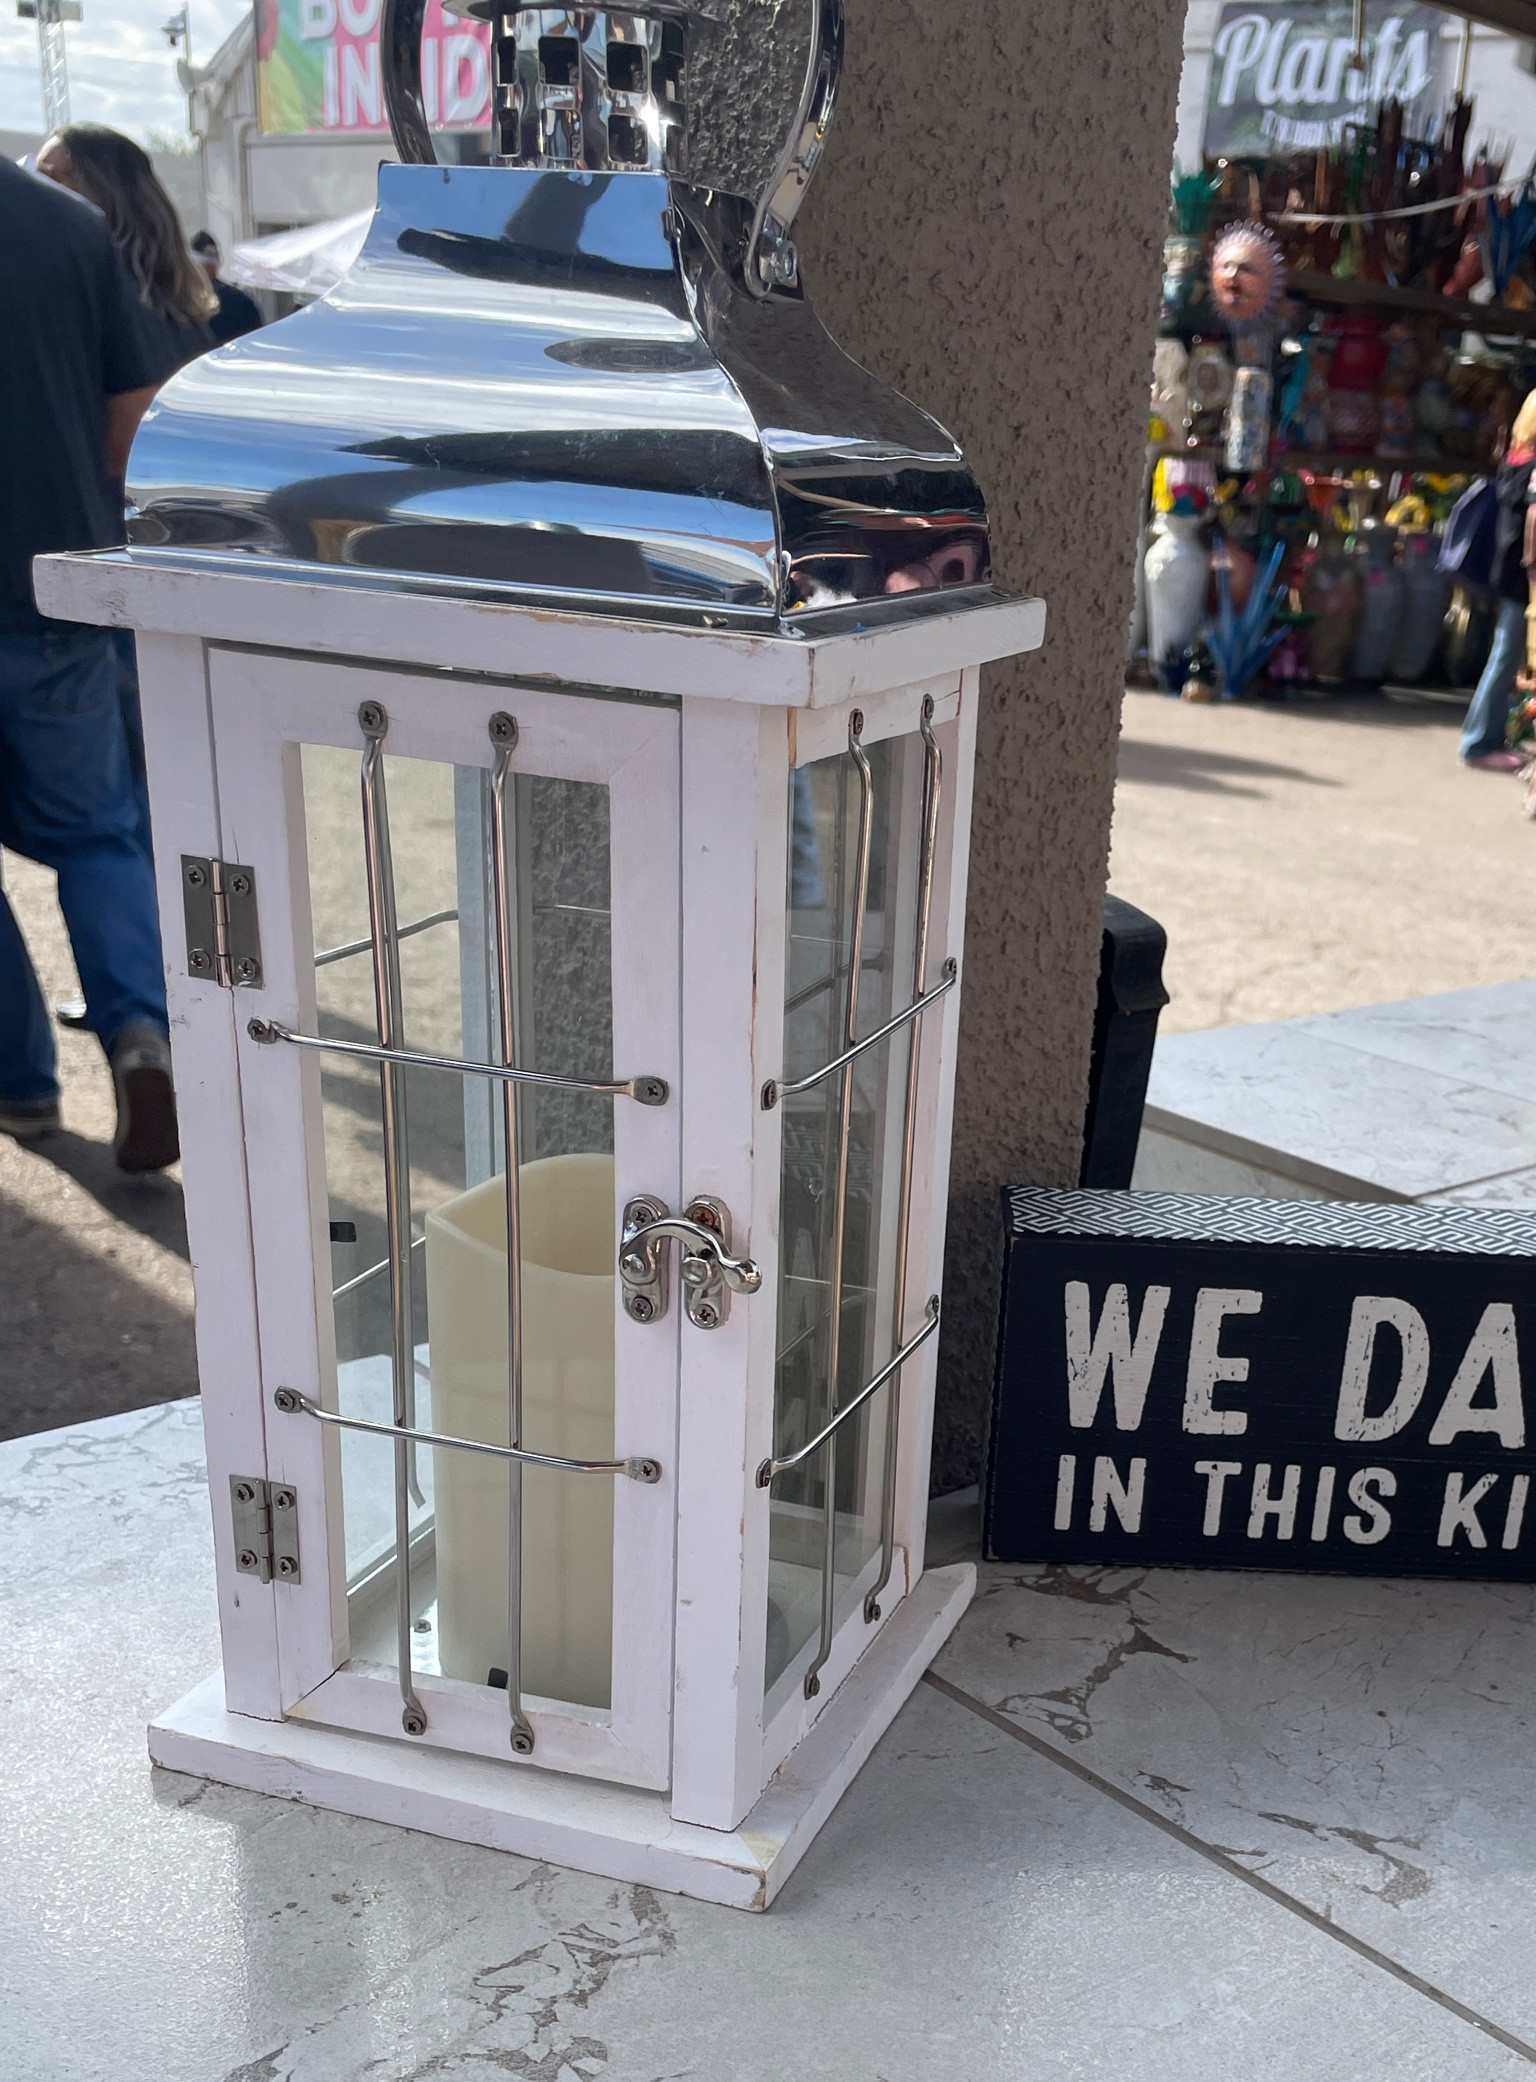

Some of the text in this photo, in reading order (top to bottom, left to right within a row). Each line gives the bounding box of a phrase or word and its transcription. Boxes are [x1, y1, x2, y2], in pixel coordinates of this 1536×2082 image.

[1214, 14, 1433, 107] Plants
[1064, 1280, 1526, 1449] WE DA
[1053, 1454, 1531, 1550] IN THIS KI
